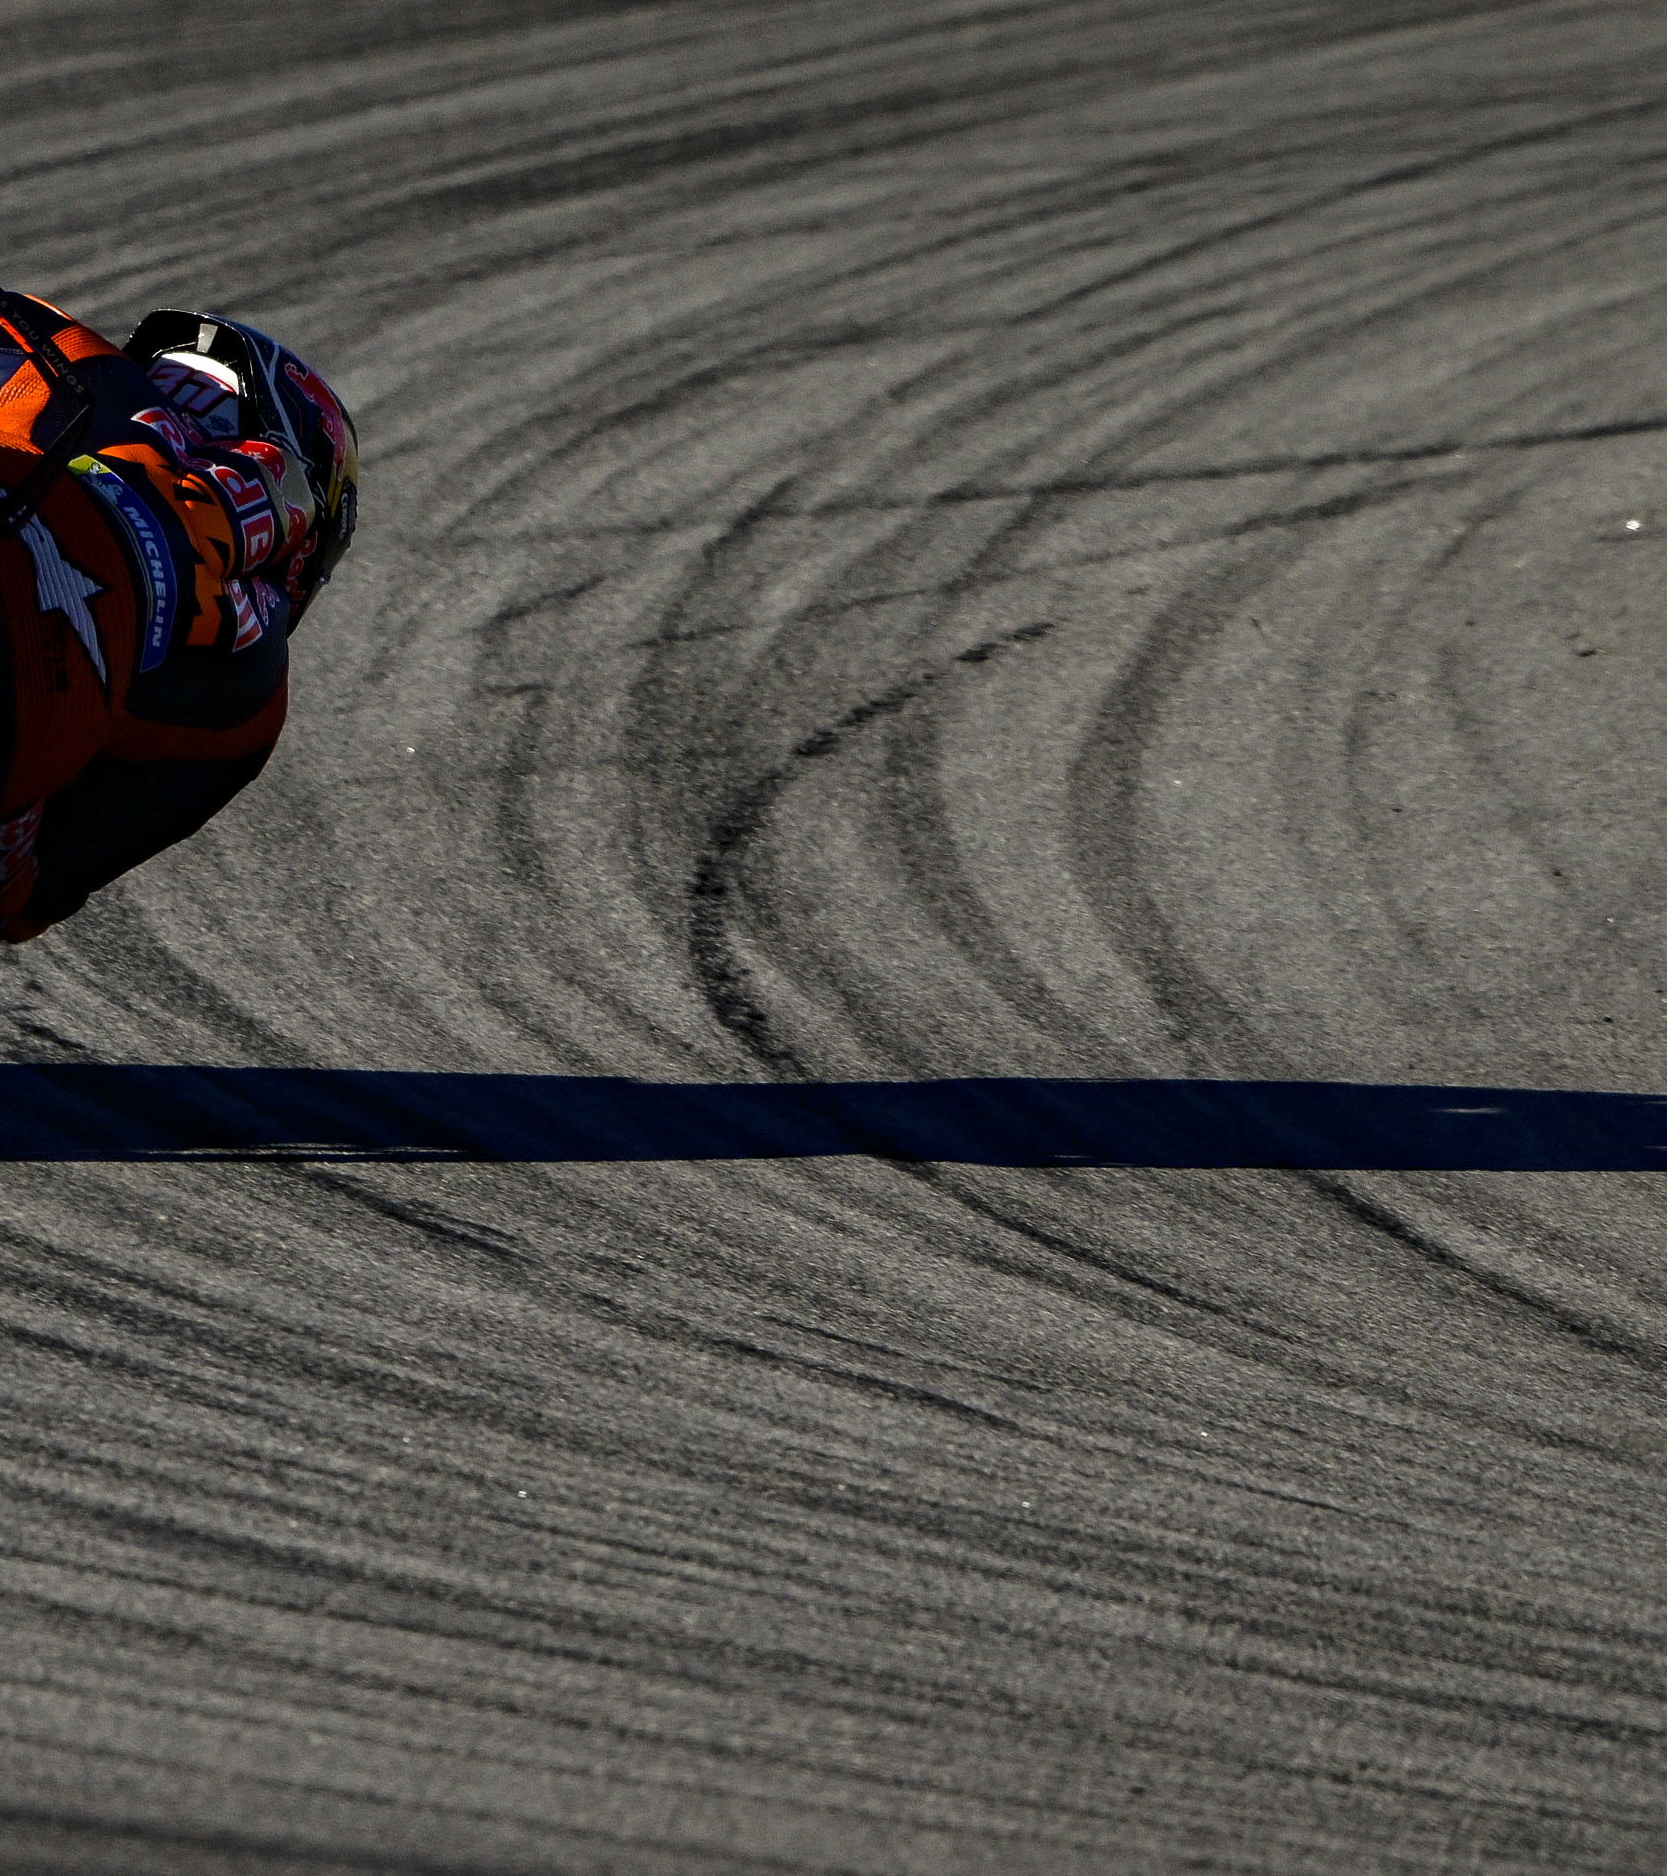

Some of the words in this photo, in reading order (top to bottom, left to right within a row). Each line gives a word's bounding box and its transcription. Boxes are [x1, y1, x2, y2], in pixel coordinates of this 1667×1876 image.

[11, 308, 41, 342] YOU
[41, 343, 85, 396] WINGS
[123, 506, 167, 648] MICHELIN
